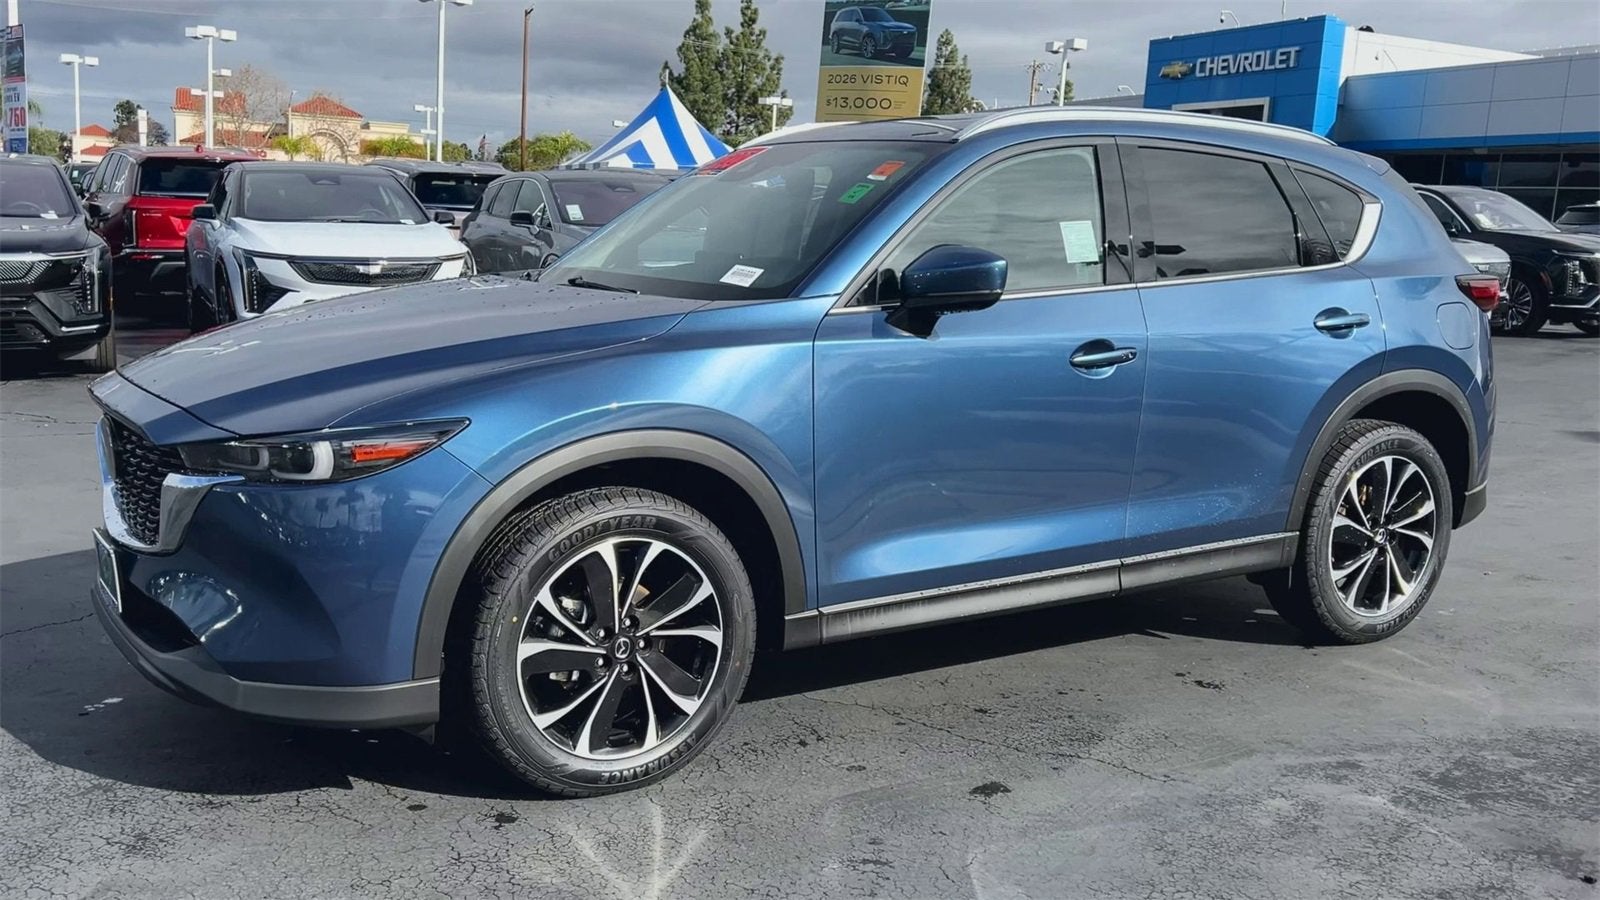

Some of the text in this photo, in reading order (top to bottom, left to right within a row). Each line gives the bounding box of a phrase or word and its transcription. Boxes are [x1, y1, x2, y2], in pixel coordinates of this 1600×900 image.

[1195, 46, 1300, 77] CHEVROLET
[827, 73, 909, 87] 2026 VISTIQ
[826, 96, 892, 110] $13,000
[547, 515, 657, 562] GOODYEAR
[598, 732, 697, 785] ASSURANCE
